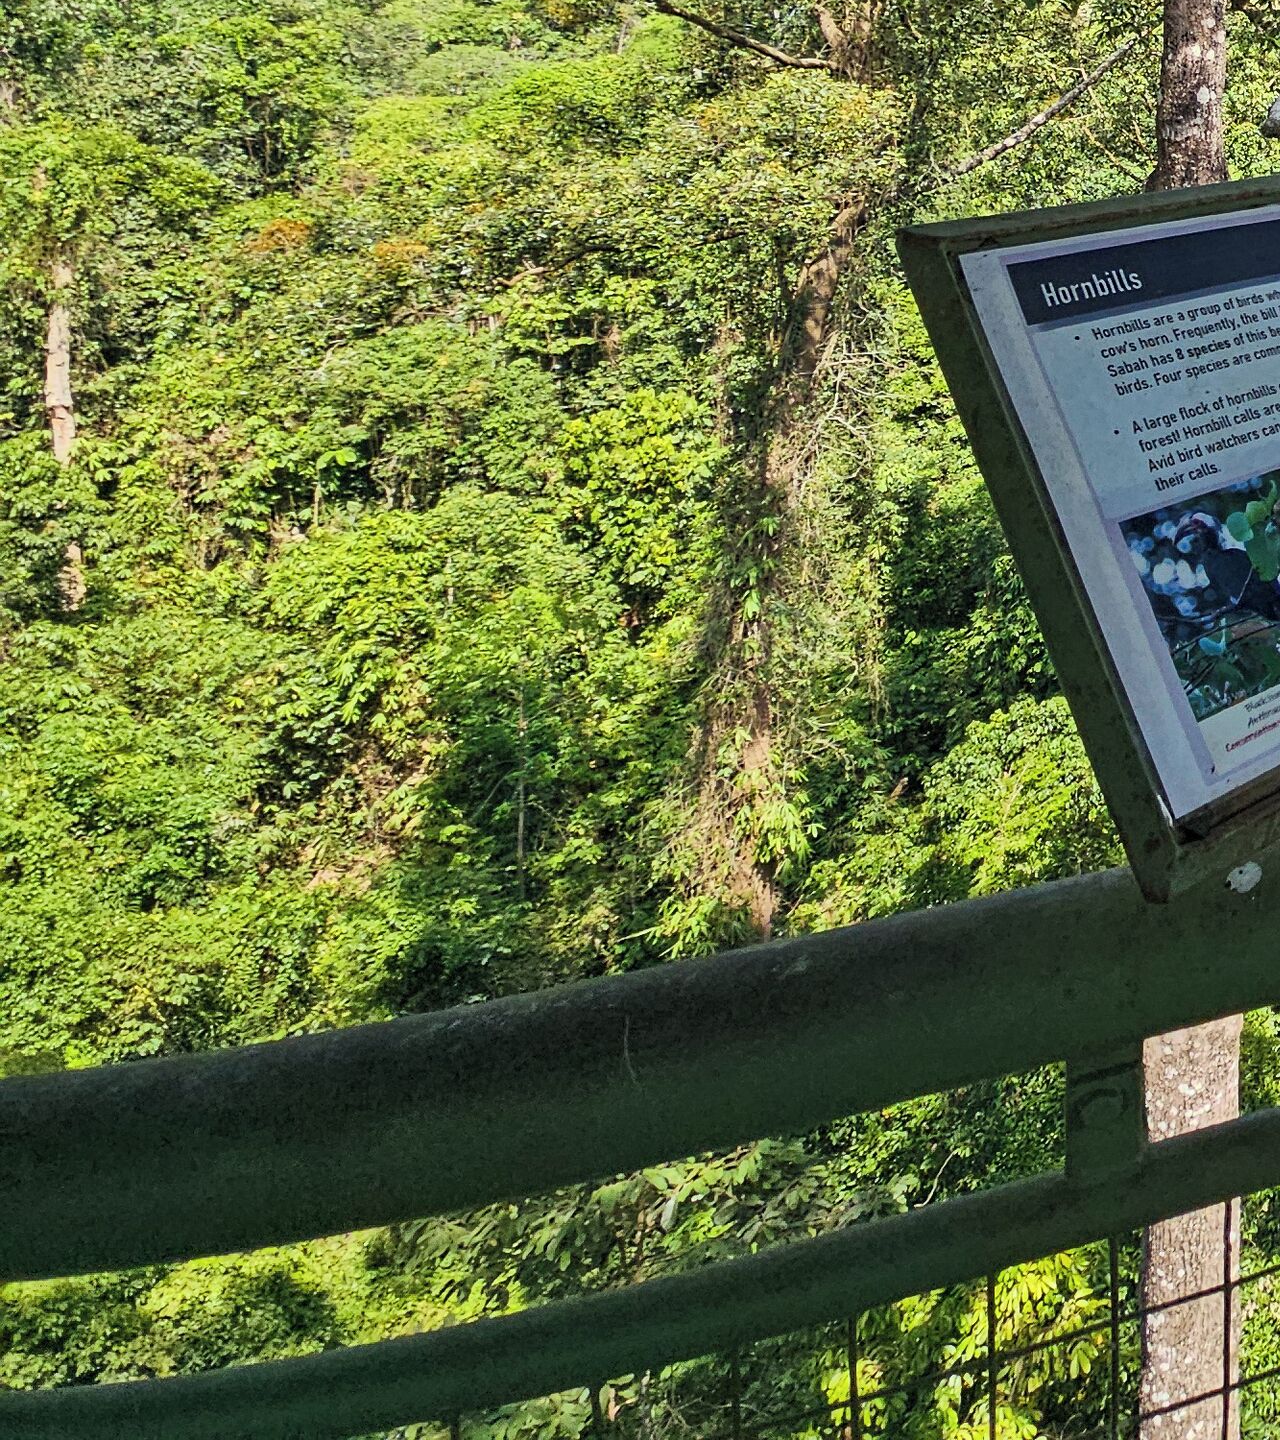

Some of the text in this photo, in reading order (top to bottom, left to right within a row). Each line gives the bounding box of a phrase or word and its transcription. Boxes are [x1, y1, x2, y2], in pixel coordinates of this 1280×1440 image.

[1040, 269, 1143, 307] Hornbills
[1092, 319, 1150, 340] Hornbills
[1154, 315, 1173, 327] are
[1177, 312, 1185, 321] a
[1187, 304, 1221, 321] group
[1224, 298, 1234, 310] of
[1236, 293, 1264, 308] birds
[1100, 341, 1137, 359] cow's
[1138, 336, 1172, 350] horn.
[1173, 315, 1240, 340] Frequently,
[1240, 312, 1259, 326] the
[1261, 308, 1278, 320] bill
[1107, 358, 1149, 377] Sabah
[1150, 352, 1174, 366] has
[1175, 348, 1184, 360] 8
[1187, 339, 1231, 359] species
[1234, 333, 1245, 346] of
[1247, 328, 1267, 342] this
[1115, 378, 1153, 396] birds.
[1154, 370, 1182, 386] Four
[1185, 361, 1230, 378] species
[1233, 353, 1252, 366] are
[1132, 421, 1142, 434] A
[1143, 413, 1177, 430] large
[1179, 401, 1209, 420] flock
[1213, 397, 1224, 410] of
[1227, 384, 1277, 406] hornbills
[1139, 430, 1181, 453] forest!
[1182, 415, 1231, 439] Hornbill
[1234, 408, 1261, 425] calls
[1148, 453, 1175, 472] Avid
[1178, 446, 1203, 462] bird
[1205, 430, 1260, 454] watchers
[1154, 463, 1221, 491] their calls.
